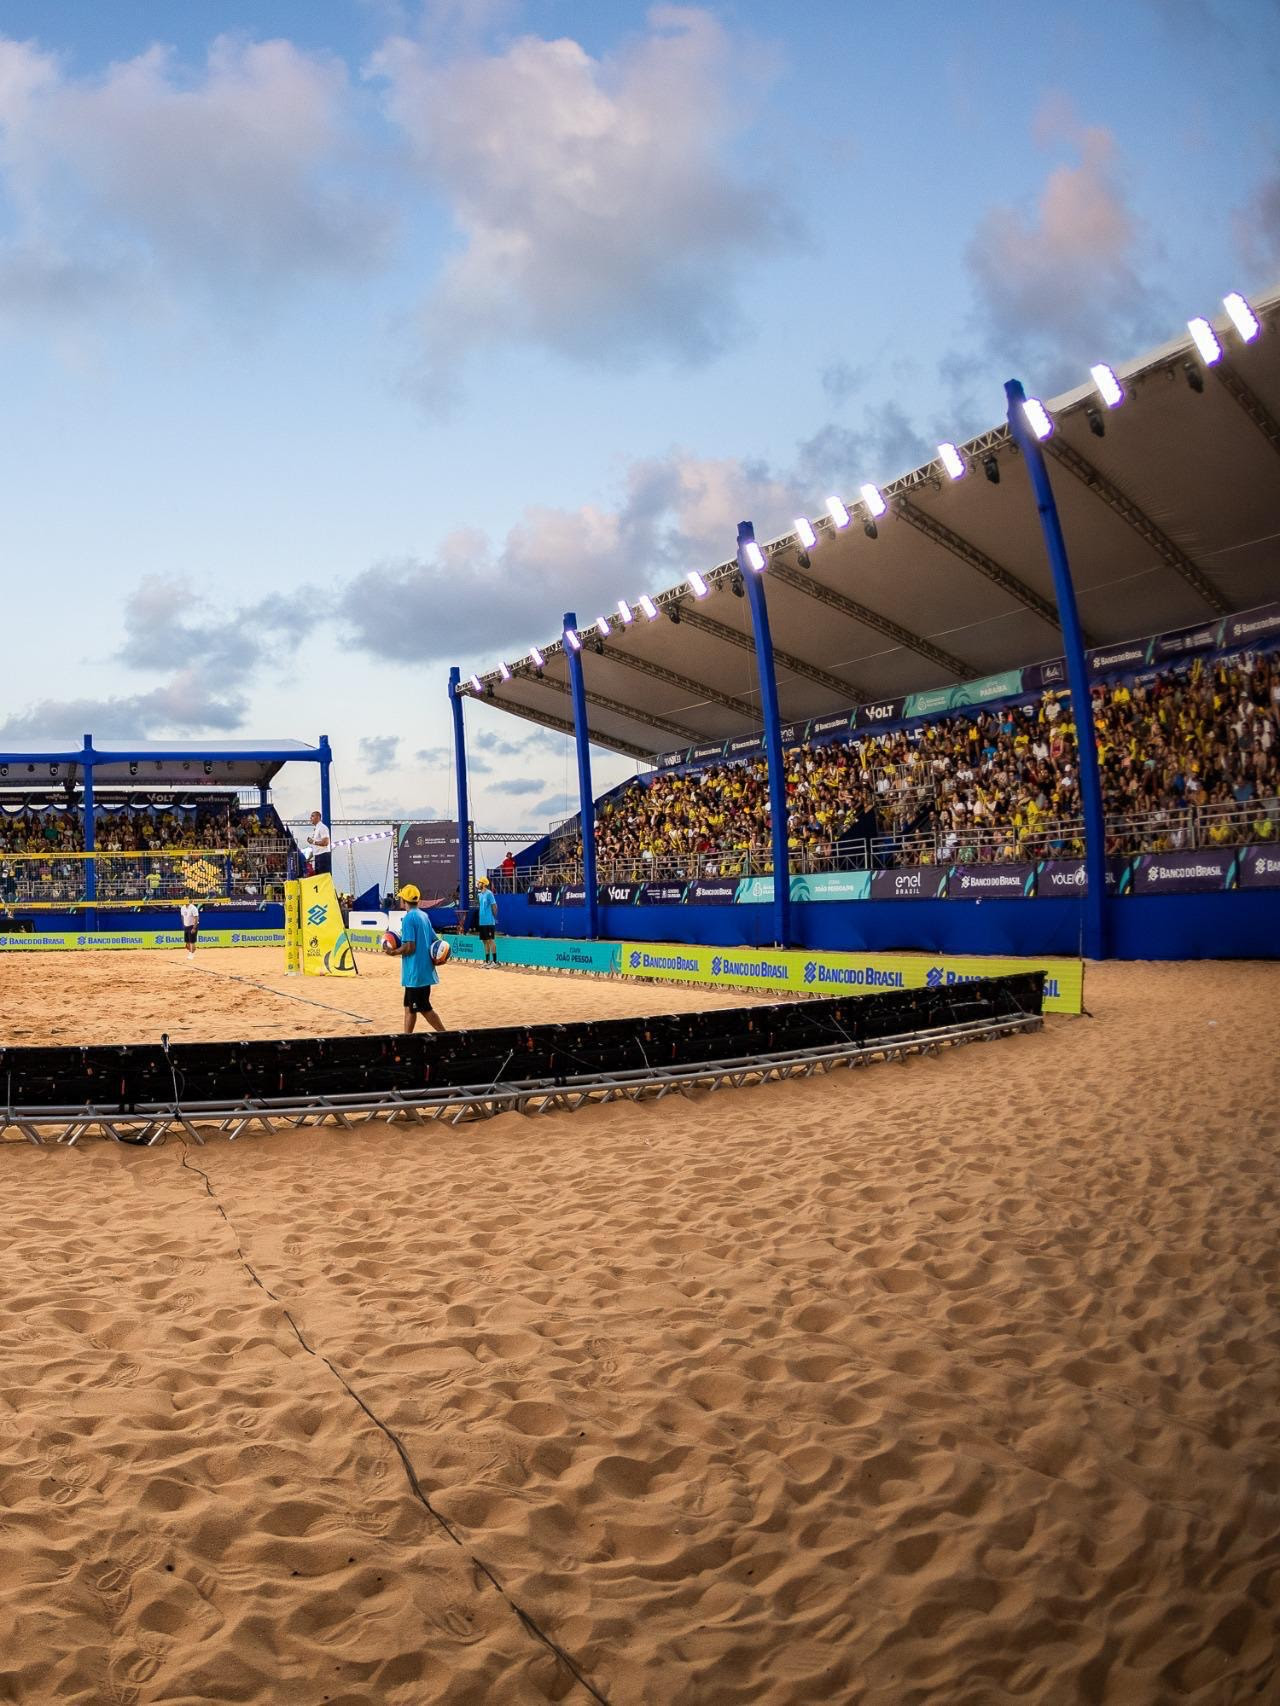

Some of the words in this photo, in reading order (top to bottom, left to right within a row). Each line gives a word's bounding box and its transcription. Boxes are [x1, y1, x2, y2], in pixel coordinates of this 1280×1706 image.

[866, 705, 895, 721] VOLT
[1160, 867, 1184, 878] BANCO
[1185, 867, 1195, 877] DO
[1195, 865, 1222, 877] BRASIL
[895, 872, 920, 887] enel
[971, 877, 990, 886] BANCO
[991, 877, 999, 886] DO
[1000, 876, 1021, 885] BRASIL
[313, 885, 318, 894] 1
[608, 886, 630, 900] VOLT
[43, 937, 65, 945] BRASIL
[643, 954, 666, 968] BANCO
[667, 957, 676, 970] DO
[676, 956, 699, 972] BRASIL
[723, 959, 749, 976] BANCO
[749, 963, 760, 977] DO
[761, 961, 789, 979] BRASIL
[818, 965, 848, 983] BANCO
[848, 969, 864, 984] DO
[865, 967, 904, 987] BRASIL
